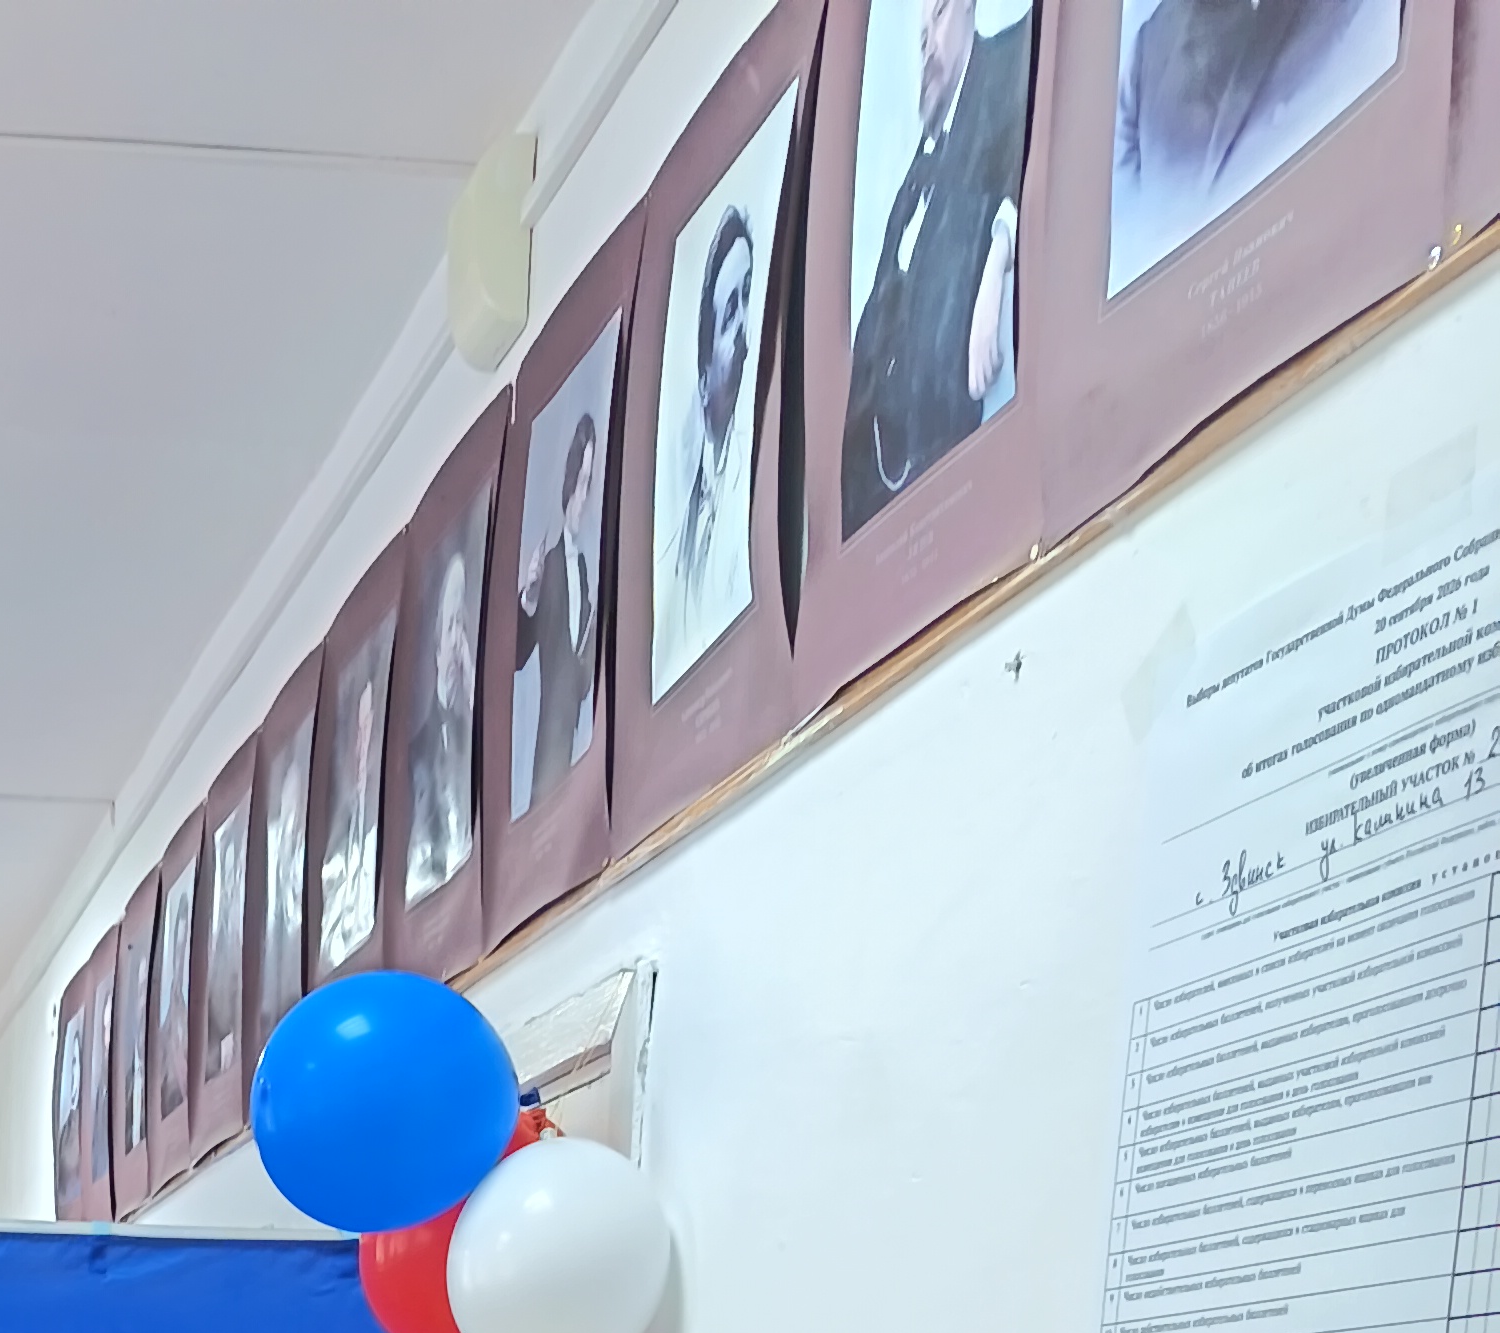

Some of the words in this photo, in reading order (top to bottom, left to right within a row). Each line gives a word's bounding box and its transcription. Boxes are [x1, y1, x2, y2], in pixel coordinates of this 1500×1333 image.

[1375, 611, 1451, 665] ПРОТОКОЛ
[1383, 627, 1474, 687] избирательной
[1305, 779, 1398, 836] ИЗБИРАТЕЛЬНЫЙ
[1402, 756, 1460, 792] УЧАСТОК
[1464, 766, 1486, 800] 13
